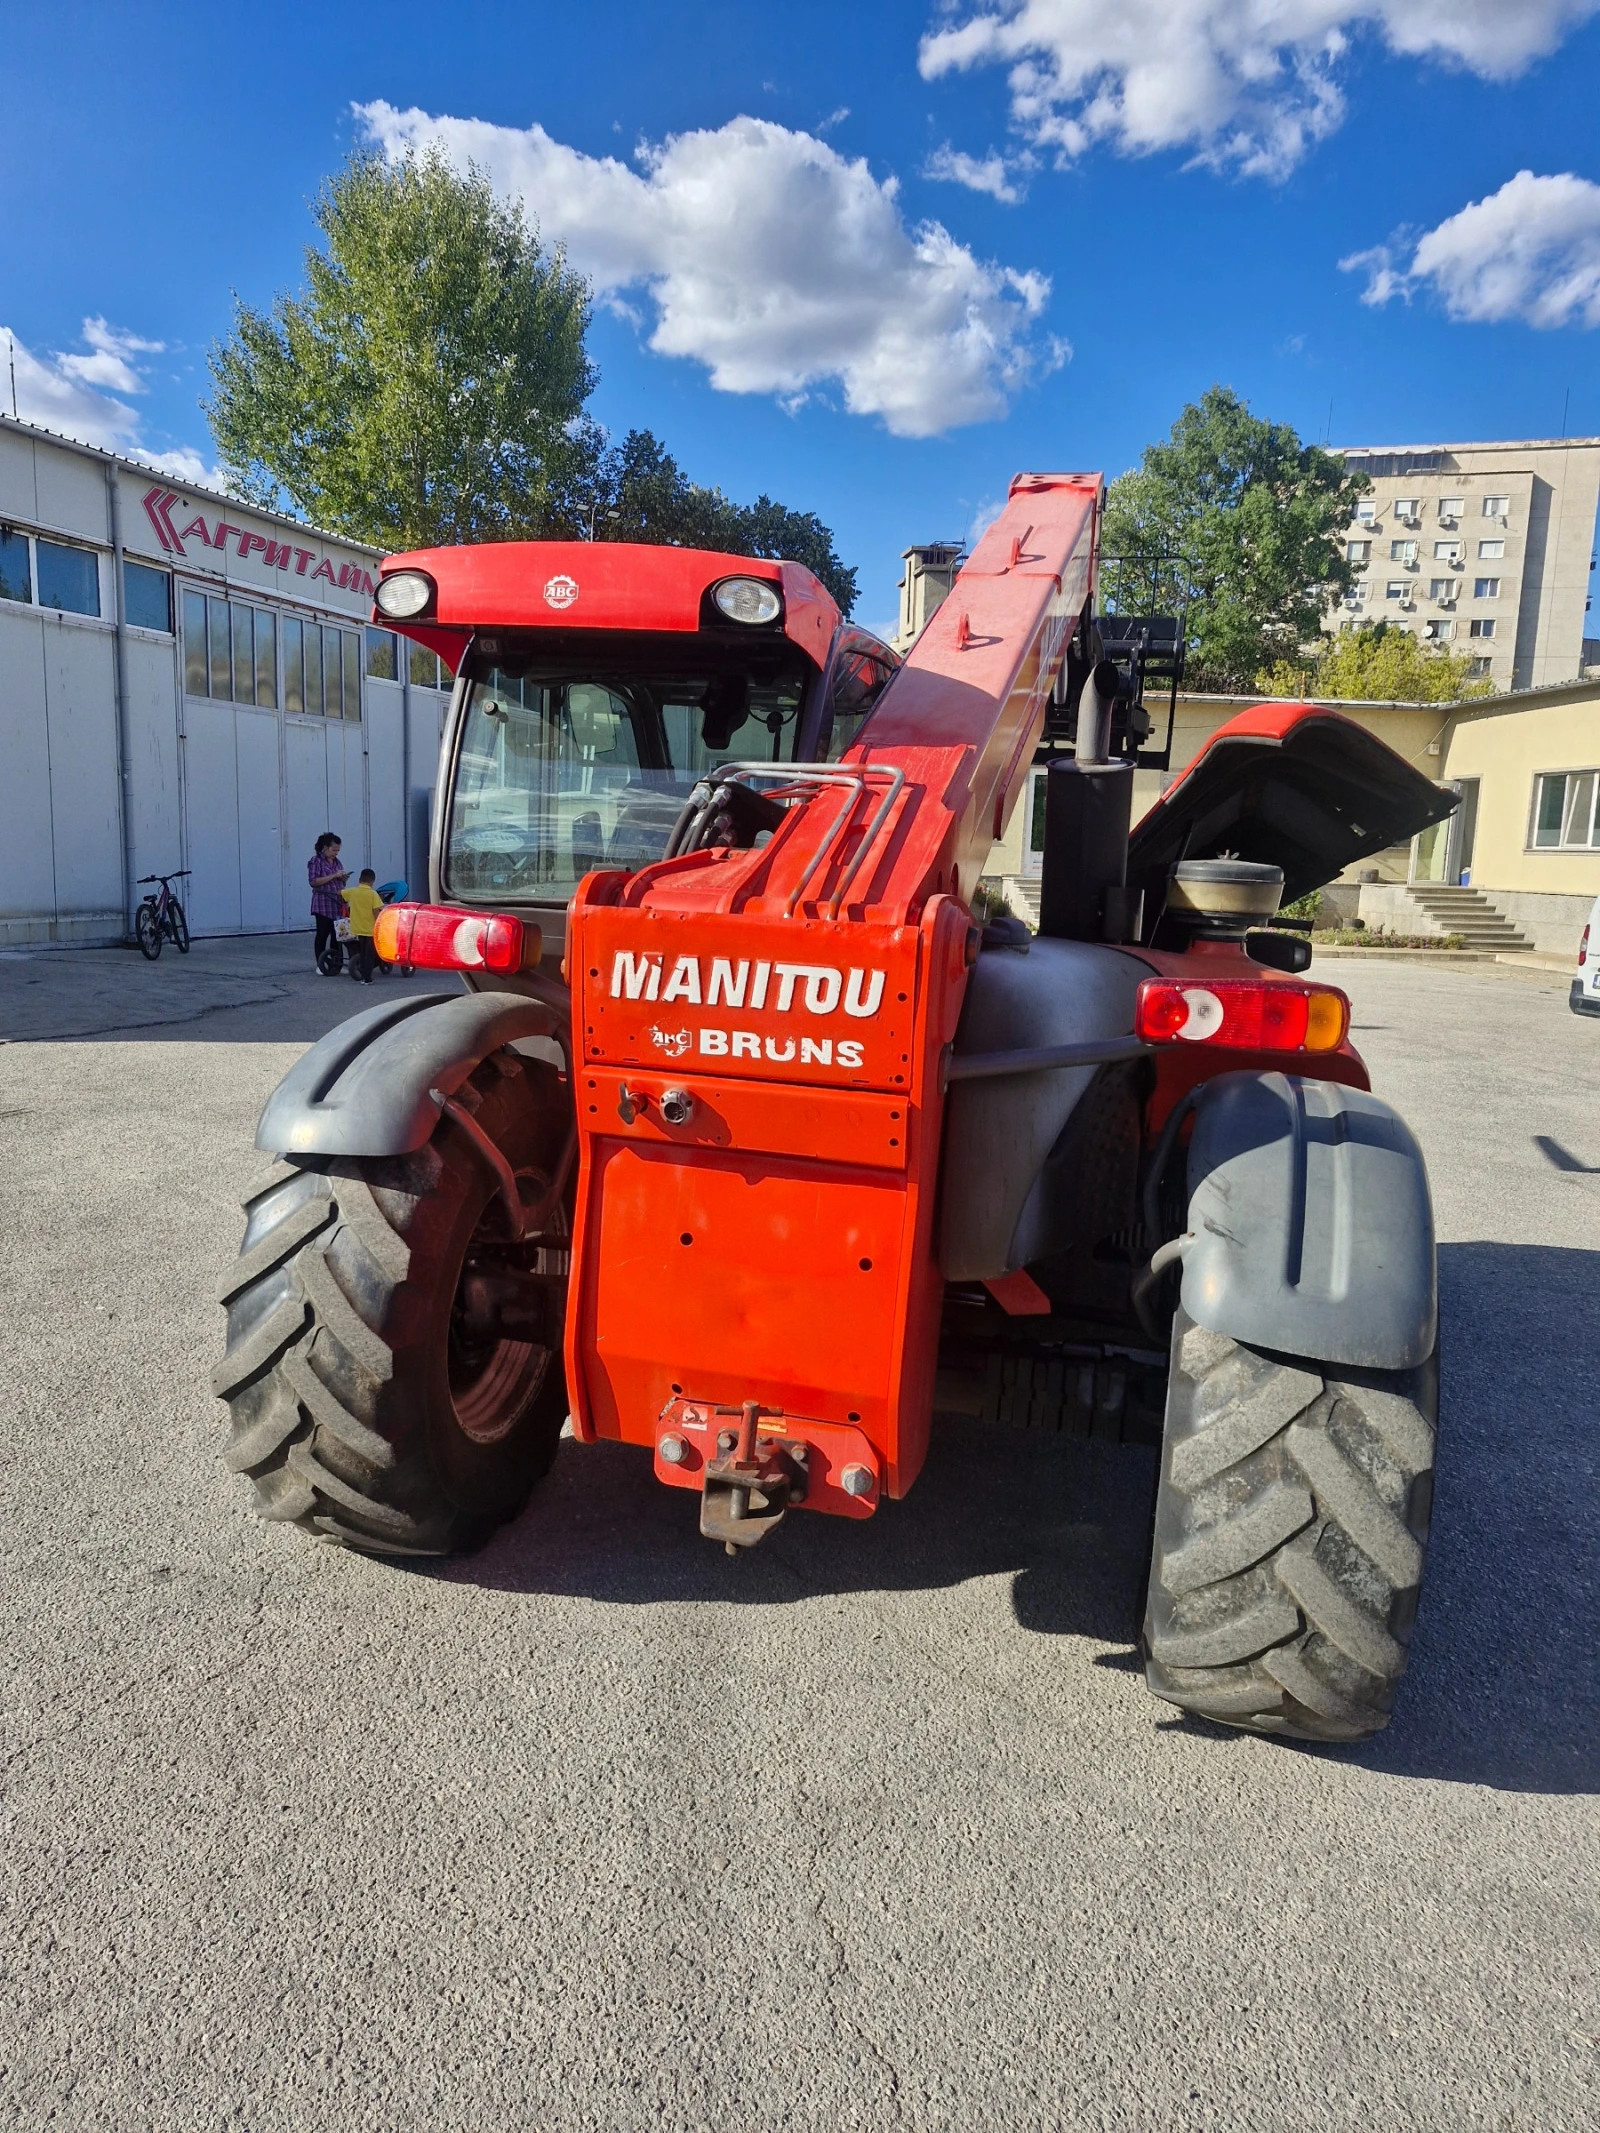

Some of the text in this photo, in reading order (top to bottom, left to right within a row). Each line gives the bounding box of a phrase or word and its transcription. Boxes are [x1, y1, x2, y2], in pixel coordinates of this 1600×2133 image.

[545, 586, 576, 597] ABC
[610, 951, 886, 1017] MANITOU
[700, 1029, 865, 1067] BRUNS
